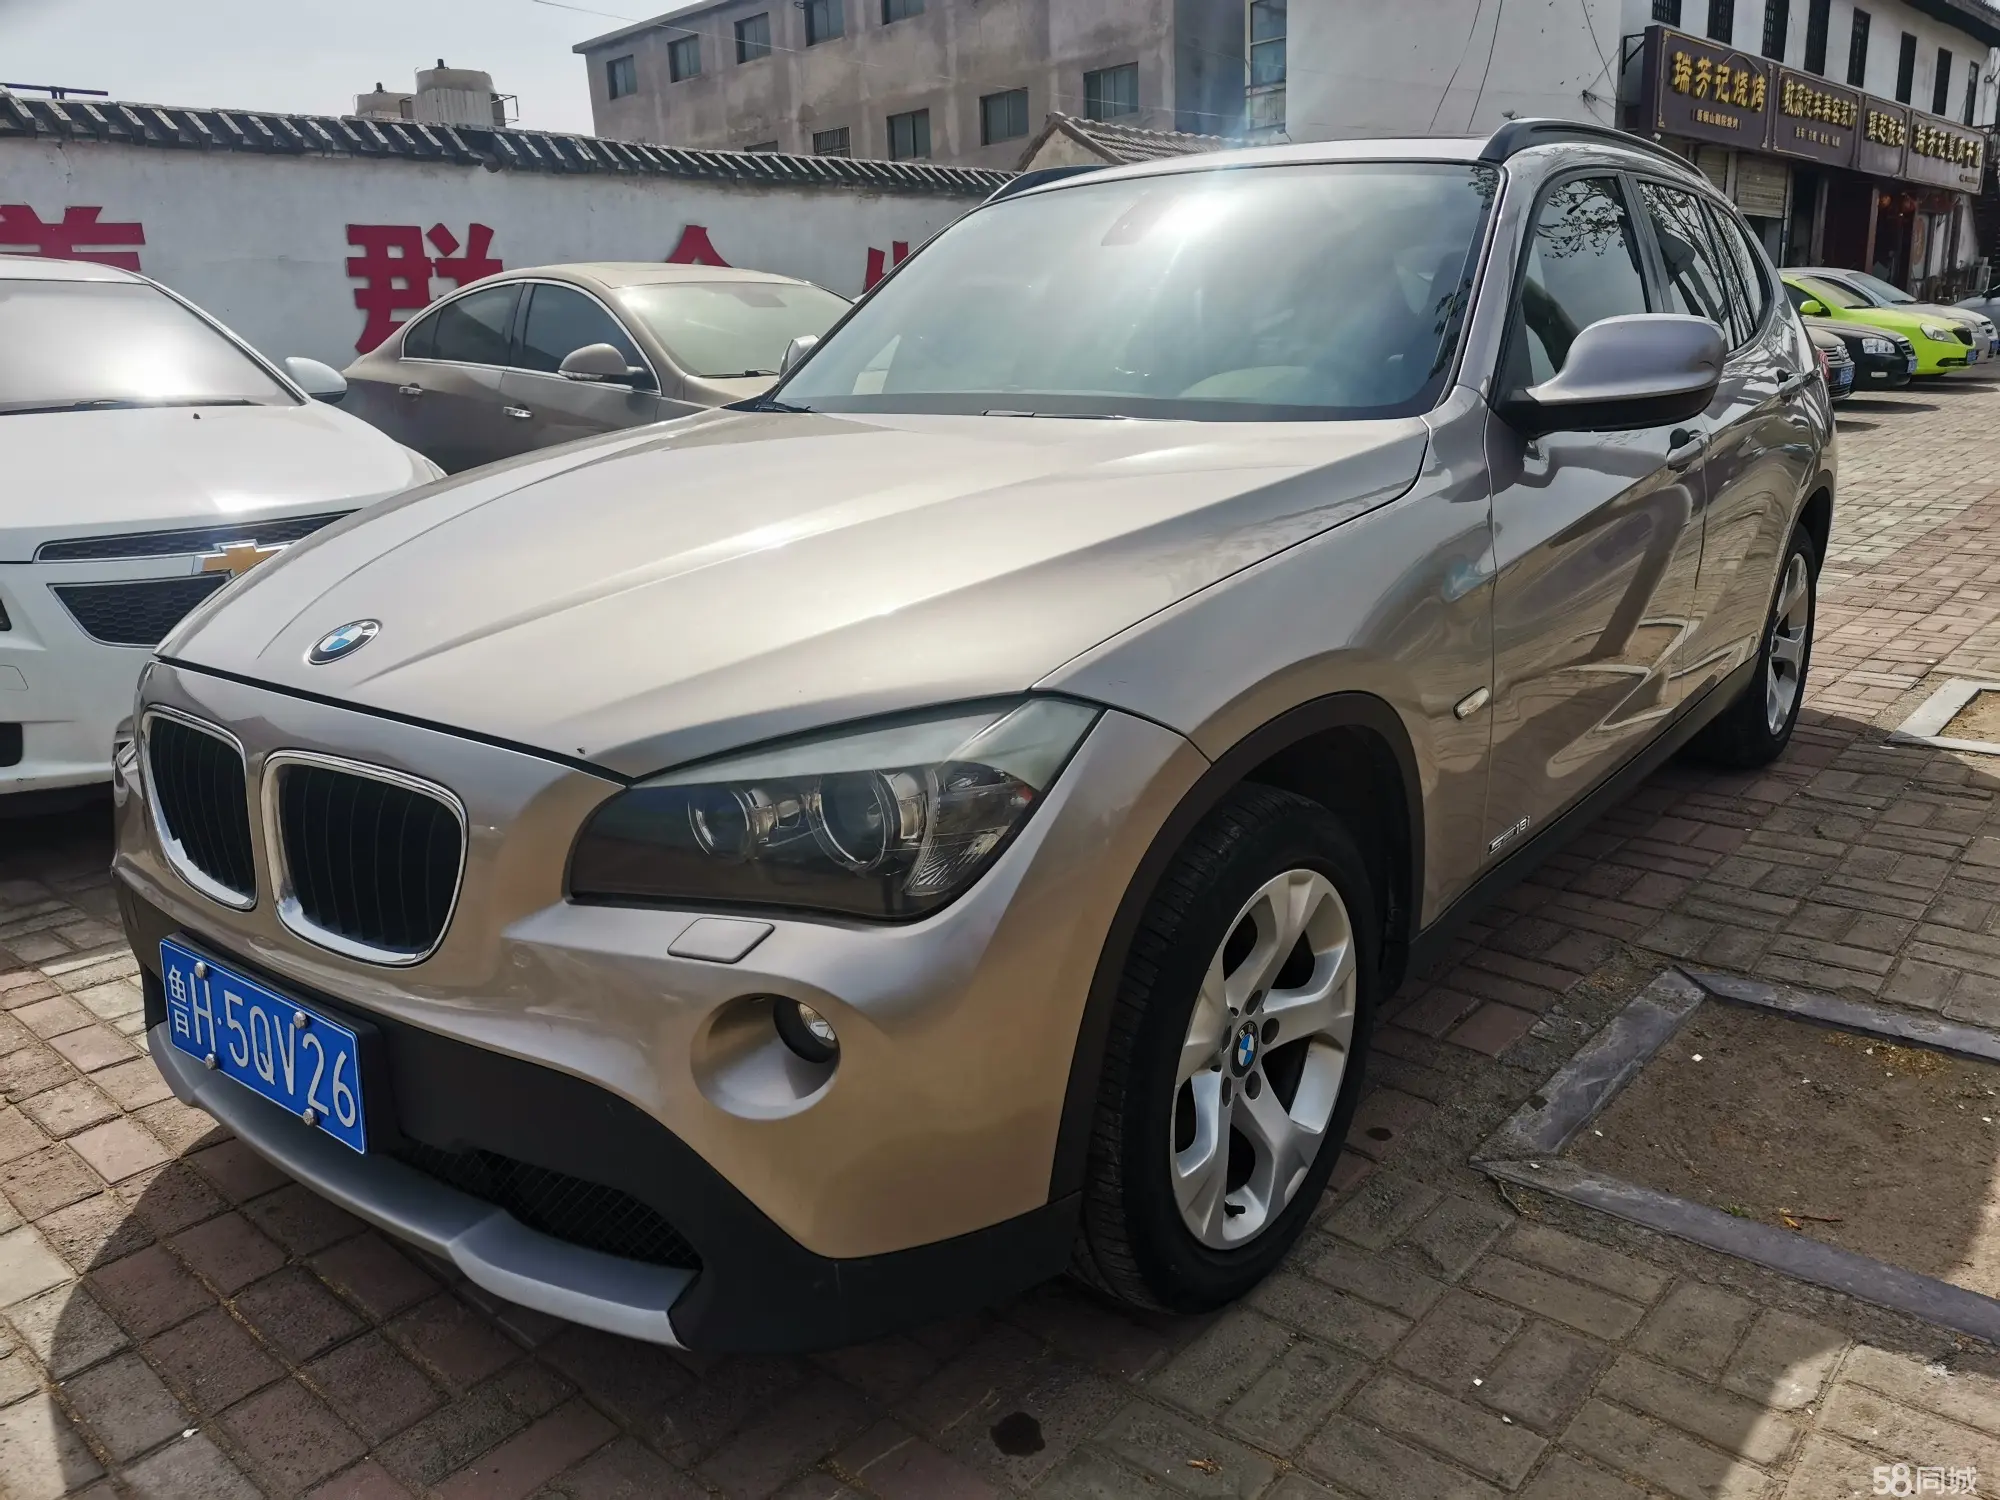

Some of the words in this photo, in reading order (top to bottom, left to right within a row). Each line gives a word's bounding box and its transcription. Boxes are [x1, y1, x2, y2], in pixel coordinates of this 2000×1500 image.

[1673, 51, 1766, 112] 瑞芳记烧烤
